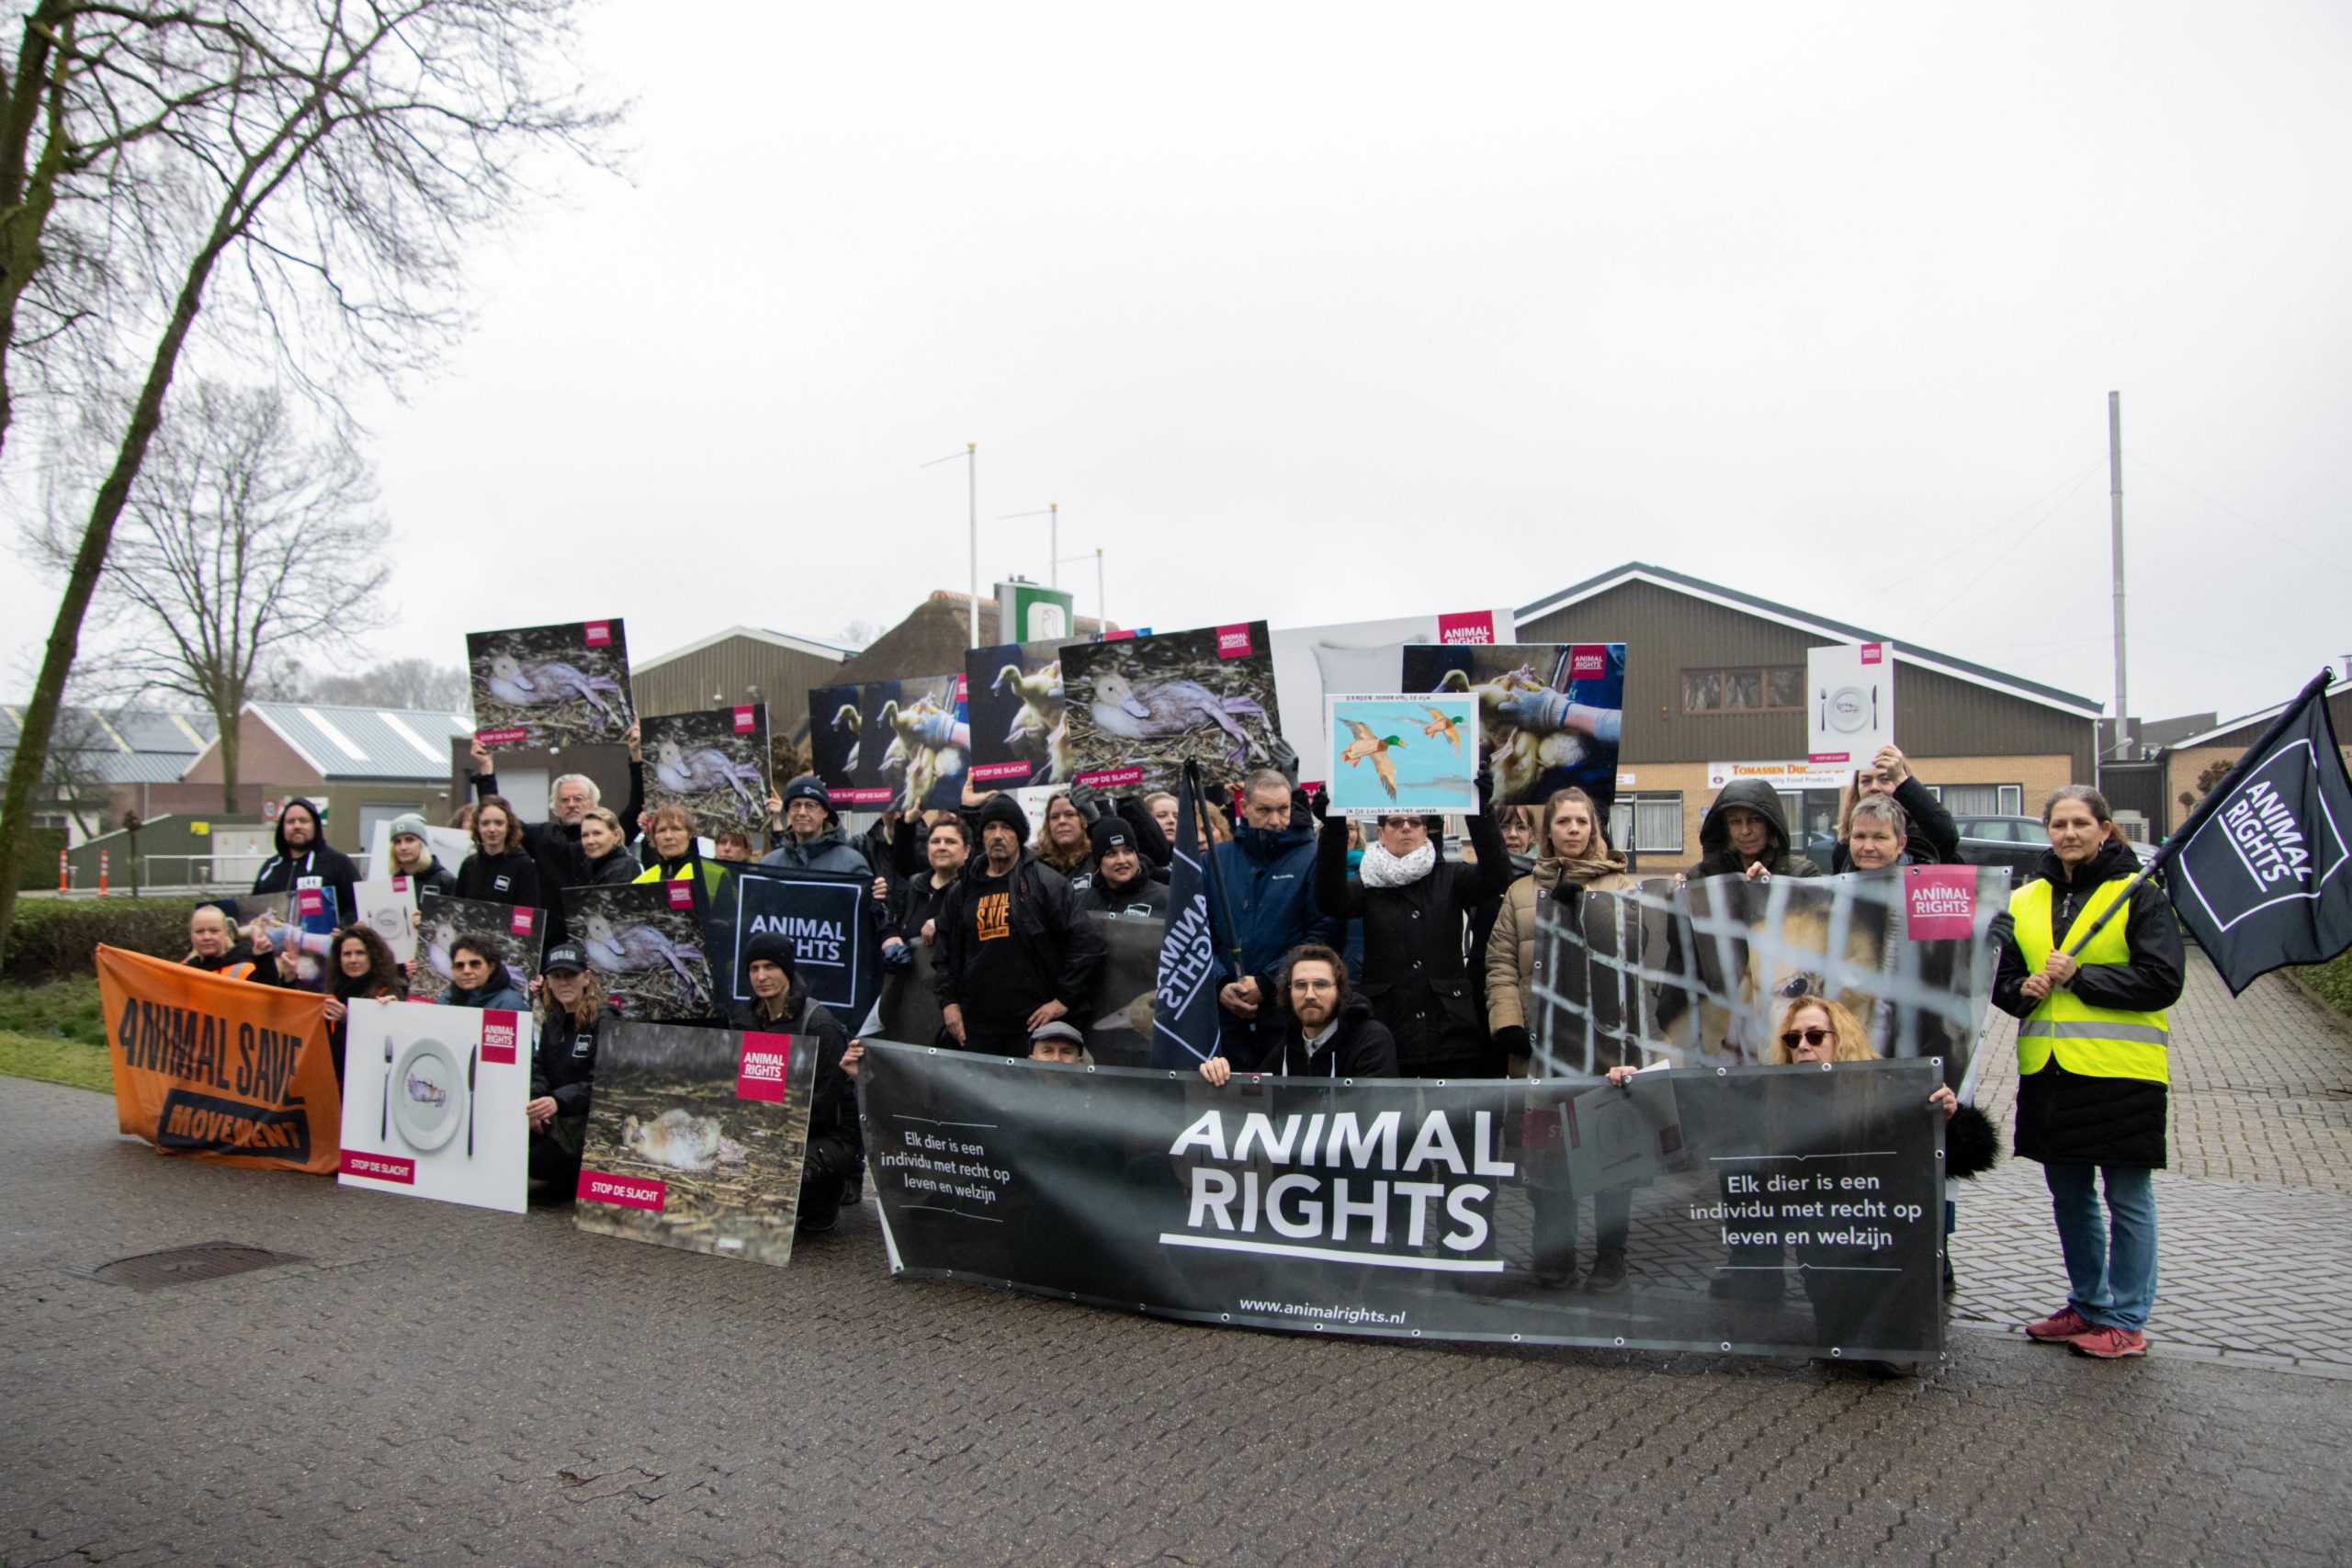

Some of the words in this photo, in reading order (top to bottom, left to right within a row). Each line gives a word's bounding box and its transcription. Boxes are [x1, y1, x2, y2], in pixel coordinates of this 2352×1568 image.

[1220, 633, 1248, 643] ANIMAL
[1443, 626, 1490, 639] ANIMAL
[1575, 655, 1603, 663] ANIMAL
[1576, 660, 1601, 669] RIGHTS
[976, 768, 992, 777] STOP
[993, 767, 1003, 775] DE
[1004, 764, 1028, 773] SLACHT
[1080, 776, 1099, 784] STOP
[1112, 772, 1139, 782] SLACHT
[2225, 799, 2290, 882] RIGHTS
[2245, 781, 2312, 882] ANIMAL
[1912, 887, 1972, 901] ANIMAL
[1916, 901, 1969, 913] RIGHTS
[750, 915, 846, 942] ANIMAL
[977, 906, 1010, 930] SAVE
[796, 939, 840, 961] HTS
[484, 1024, 514, 1036] ANIMAL
[485, 1034, 513, 1045] RIGHTS
[119, 997, 230, 1090] ANIMAL
[236, 1021, 306, 1106] SAVE
[743, 1052, 785, 1066] ANIMAL
[744, 1064, 781, 1077] RIGHTS
[166, 1105, 300, 1148] MOVEMENT
[905, 1131, 922, 1147] Elk
[924, 1134, 946, 1150] dier
[949, 1138, 959, 1153] is
[961, 1145, 984, 1156] een
[1169, 1110, 1515, 1177] ANIMAL
[351, 1159, 369, 1170] STOP
[370, 1162, 380, 1172] DE
[381, 1164, 410, 1177] SLACHT
[881, 1151, 932, 1169] individu
[933, 1159, 956, 1174] met
[959, 1162, 990, 1179] recht
[993, 1169, 1011, 1185] op
[592, 1181, 613, 1194] STOP
[613, 1186, 626, 1198] DE
[626, 1188, 658, 1201] SLACHT
[904, 1172, 937, 1191] leven
[939, 1181, 953, 1194] en
[955, 1183, 996, 1204] welzijn
[1728, 1176, 1760, 1193] Elk
[1767, 1175, 1809, 1191] dier
[1816, 1174, 1833, 1190] is
[1840, 1177, 1880, 1190] een
[1187, 1167, 1491, 1251] RIGHTS
[1690, 1200, 1774, 1220] individu
[1781, 1201, 1824, 1217] met
[1831, 1199, 1886, 1217] recht
[1894, 1204, 1922, 1223] op
[1721, 1227, 1778, 1245] leven
[1785, 1230, 1810, 1244] en
[1817, 1226, 1893, 1250] welzijn
[1239, 1298, 1406, 1325] www.animalrights.nl
